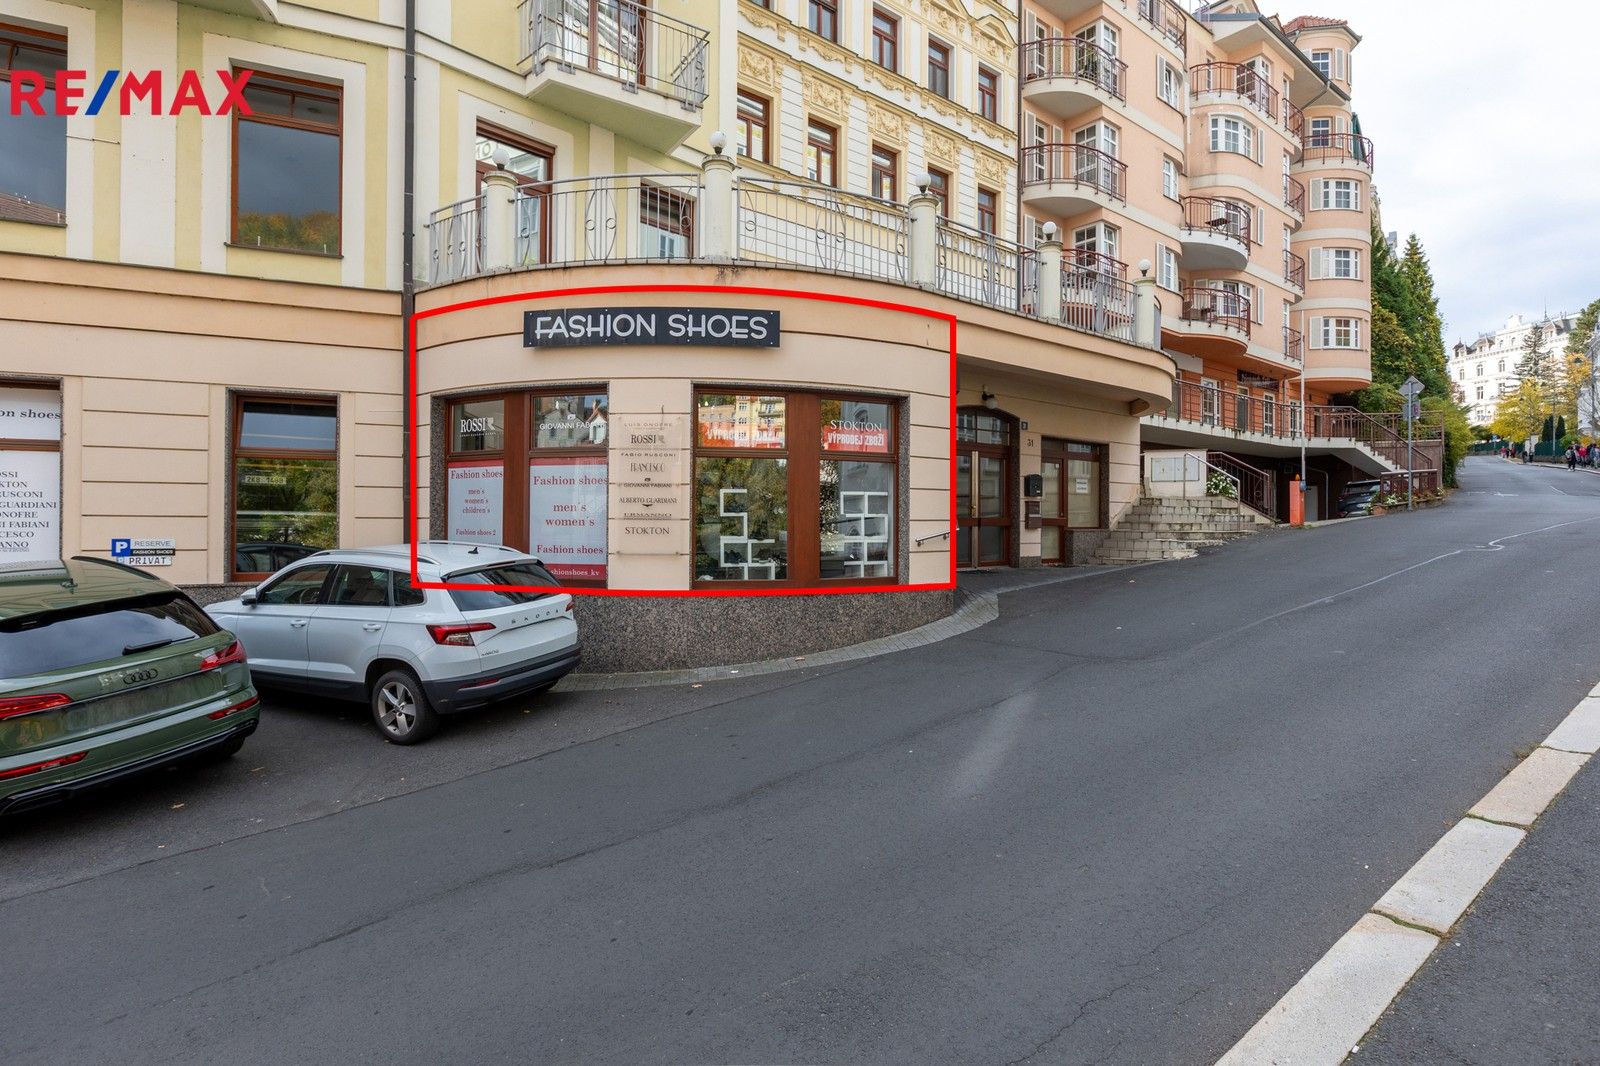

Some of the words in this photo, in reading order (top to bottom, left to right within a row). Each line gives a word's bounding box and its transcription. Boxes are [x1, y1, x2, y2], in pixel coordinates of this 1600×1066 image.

[535, 314, 655, 340] FASHION
[668, 314, 768, 340] SHOES
[20, 409, 61, 419] shoes
[460, 417, 486, 432] ROSSI
[539, 422, 575, 430] GIOVANNI
[830, 420, 882, 432] STOKTON
[631, 434, 656, 444] ROSSI
[1027, 439, 1034, 447] 31
[451, 470, 480, 479] Fashion
[482, 469, 503, 479] shoes
[533, 476, 575, 485] Fashion
[579, 475, 608, 485] shoes
[625, 527, 670, 535] STOKTON
[115, 541, 128, 553] P
[536, 544, 574, 554] Fashion
[576, 545, 604, 554] shoes
[129, 557, 166, 565] PRIVAT
